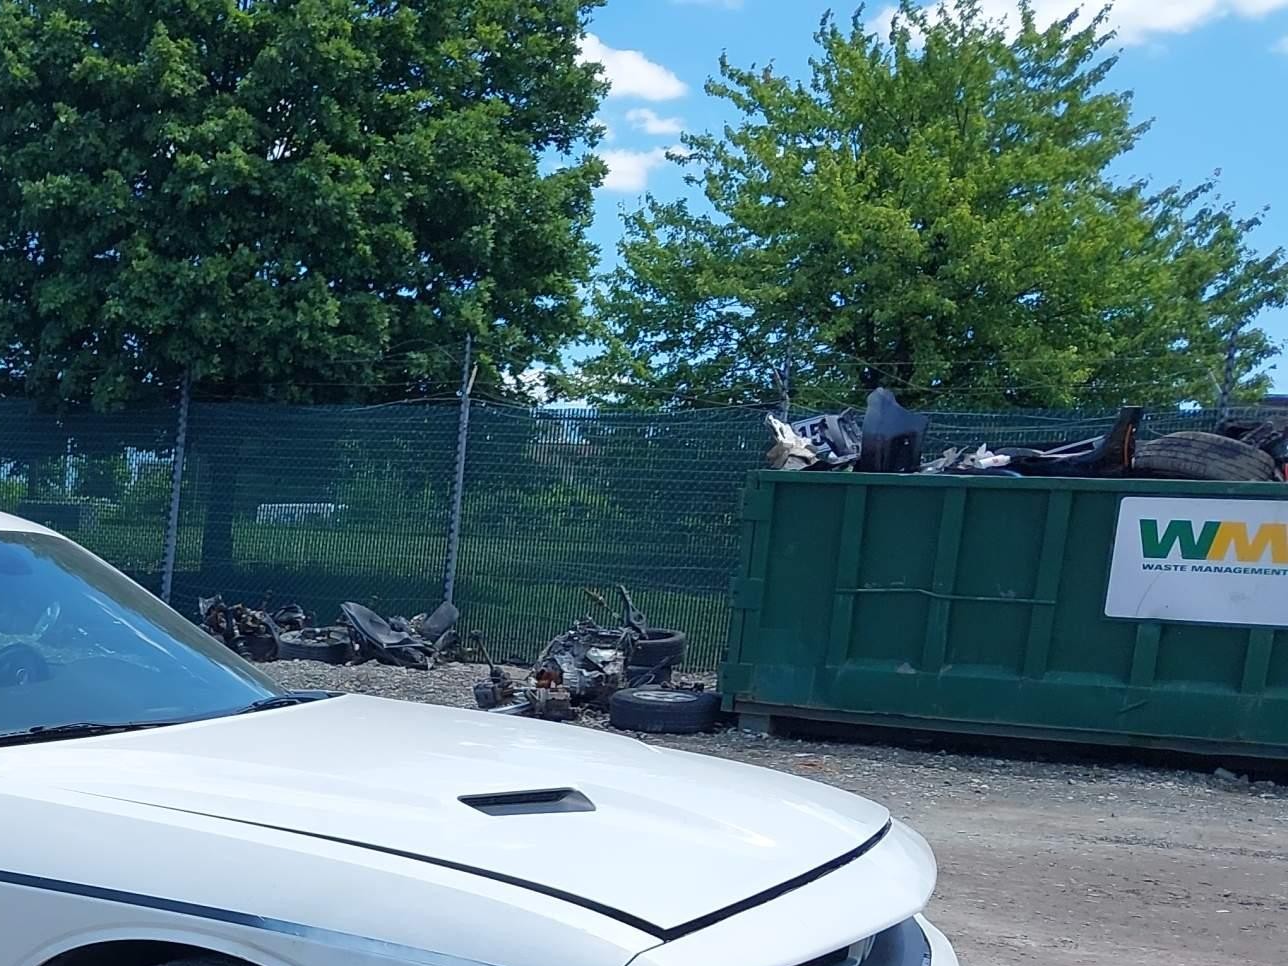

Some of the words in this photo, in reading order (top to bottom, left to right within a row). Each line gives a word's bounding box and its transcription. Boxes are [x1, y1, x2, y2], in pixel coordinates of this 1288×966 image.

[1139, 518, 1288, 564] WM
[1142, 563, 1187, 572] WASTE
[1191, 565, 1288, 576] MANAGEMENT
